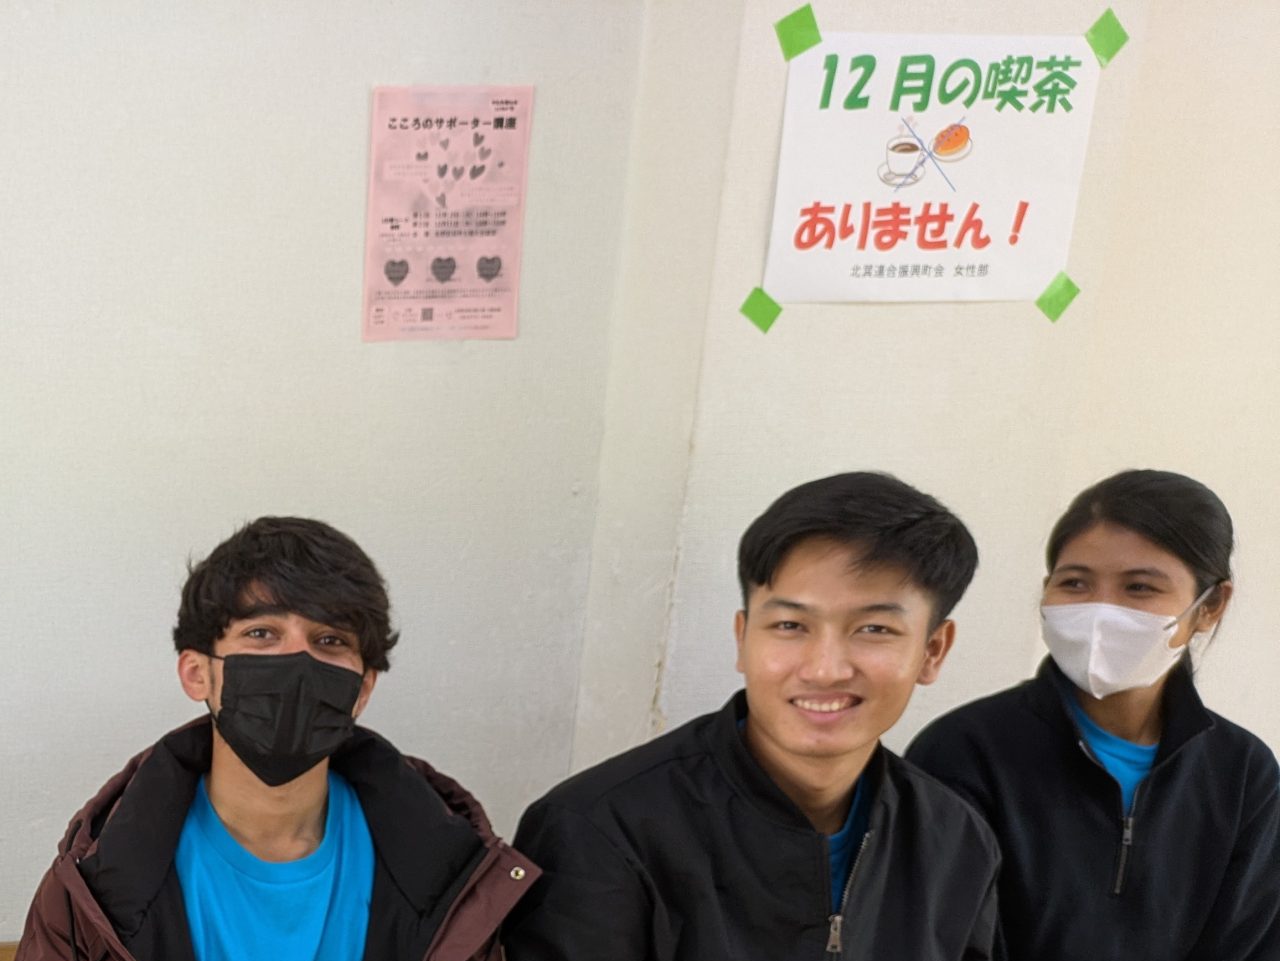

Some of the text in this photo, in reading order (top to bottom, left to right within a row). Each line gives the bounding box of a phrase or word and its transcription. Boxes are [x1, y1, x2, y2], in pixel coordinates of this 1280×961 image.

[388, 117, 517, 130] こころのサポーター講座
[793, 201, 1030, 252] ありません！
[953, 263, 989, 277] 女性部
